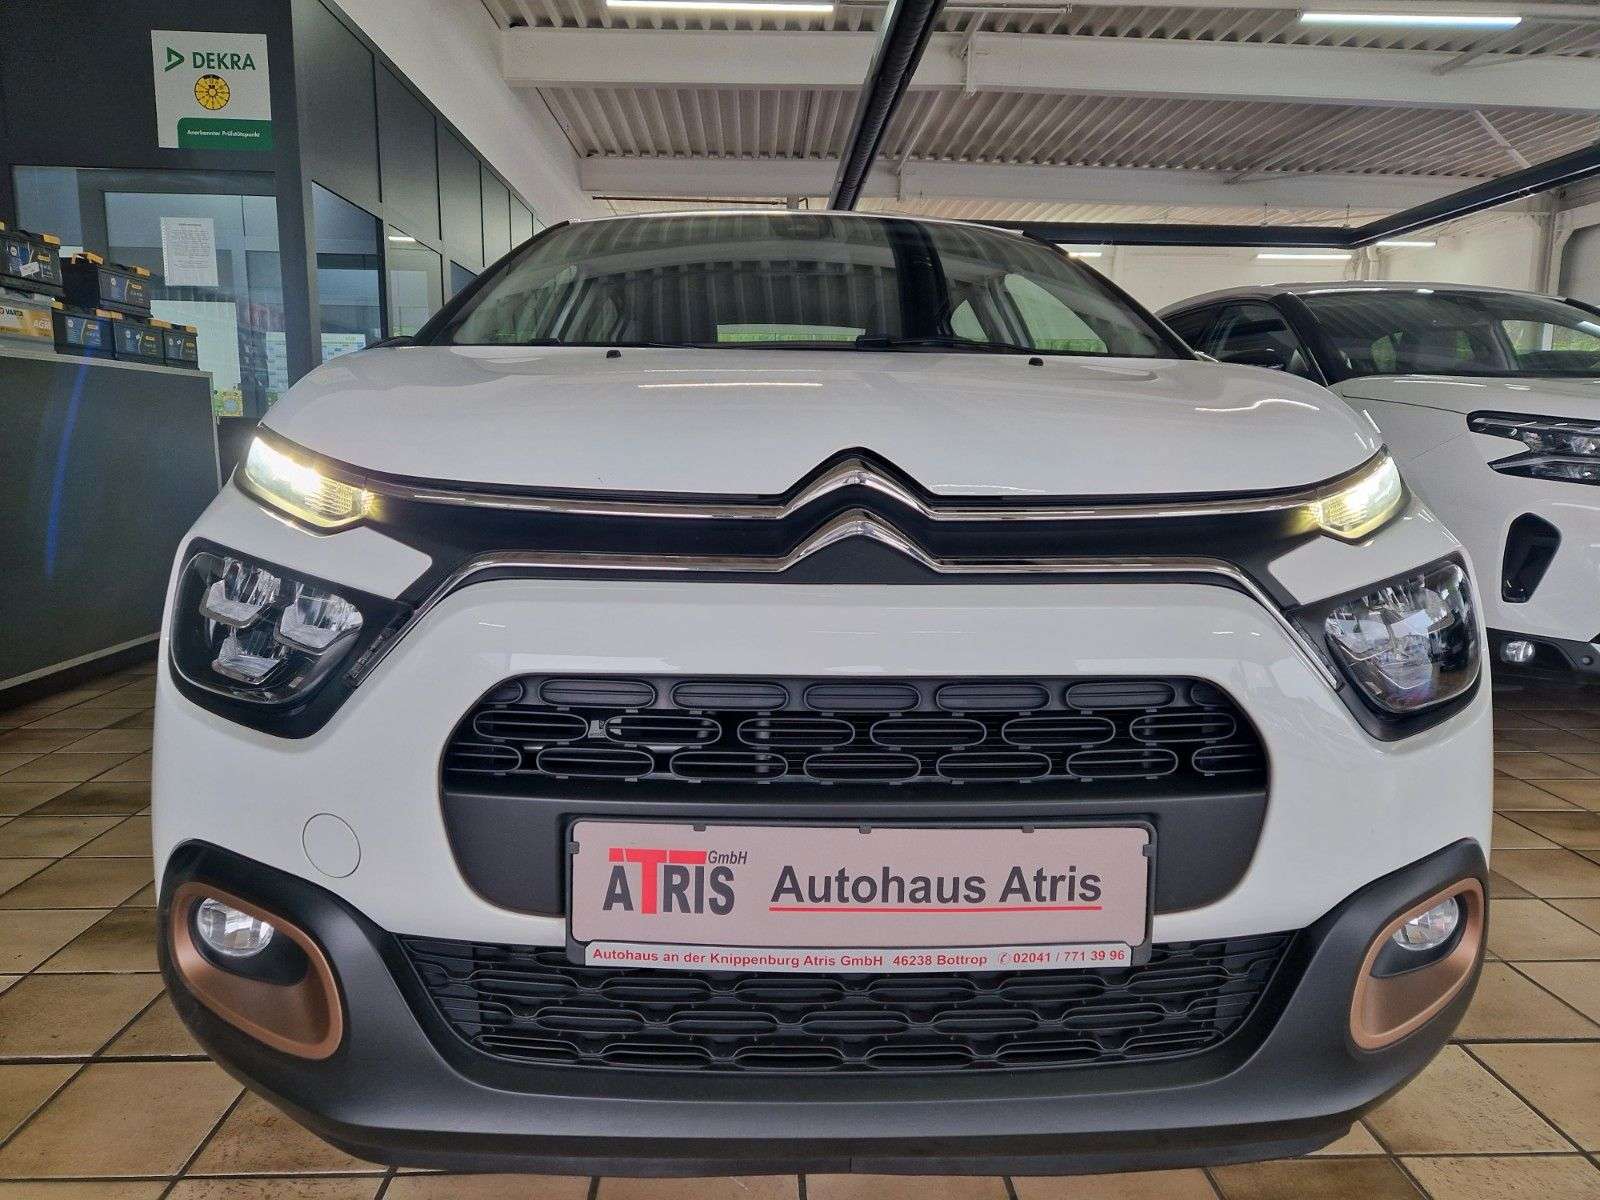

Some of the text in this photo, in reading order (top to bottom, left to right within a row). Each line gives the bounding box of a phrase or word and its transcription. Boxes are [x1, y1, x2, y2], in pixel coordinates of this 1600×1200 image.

[192, 52, 256, 71] DEKRA
[708, 850, 748, 865] GmbH
[602, 848, 735, 916] ATRIS
[770, 865, 1103, 904] Autohaus Atris
[592, 948, 659, 962] Autohaus
[663, 952, 680, 962] an
[683, 951, 705, 963] der
[710, 953, 800, 968] Knippenburg
[803, 955, 836, 966] Atris
[840, 954, 883, 966] GmbH
[892, 954, 932, 966] 46238
[936, 954, 988, 967] Bottrop
[1013, 952, 1051, 963] 02041
[1063, 951, 1086, 962] 771
[1090, 950, 1106, 961] 39
[1109, 949, 1125, 961] 96
